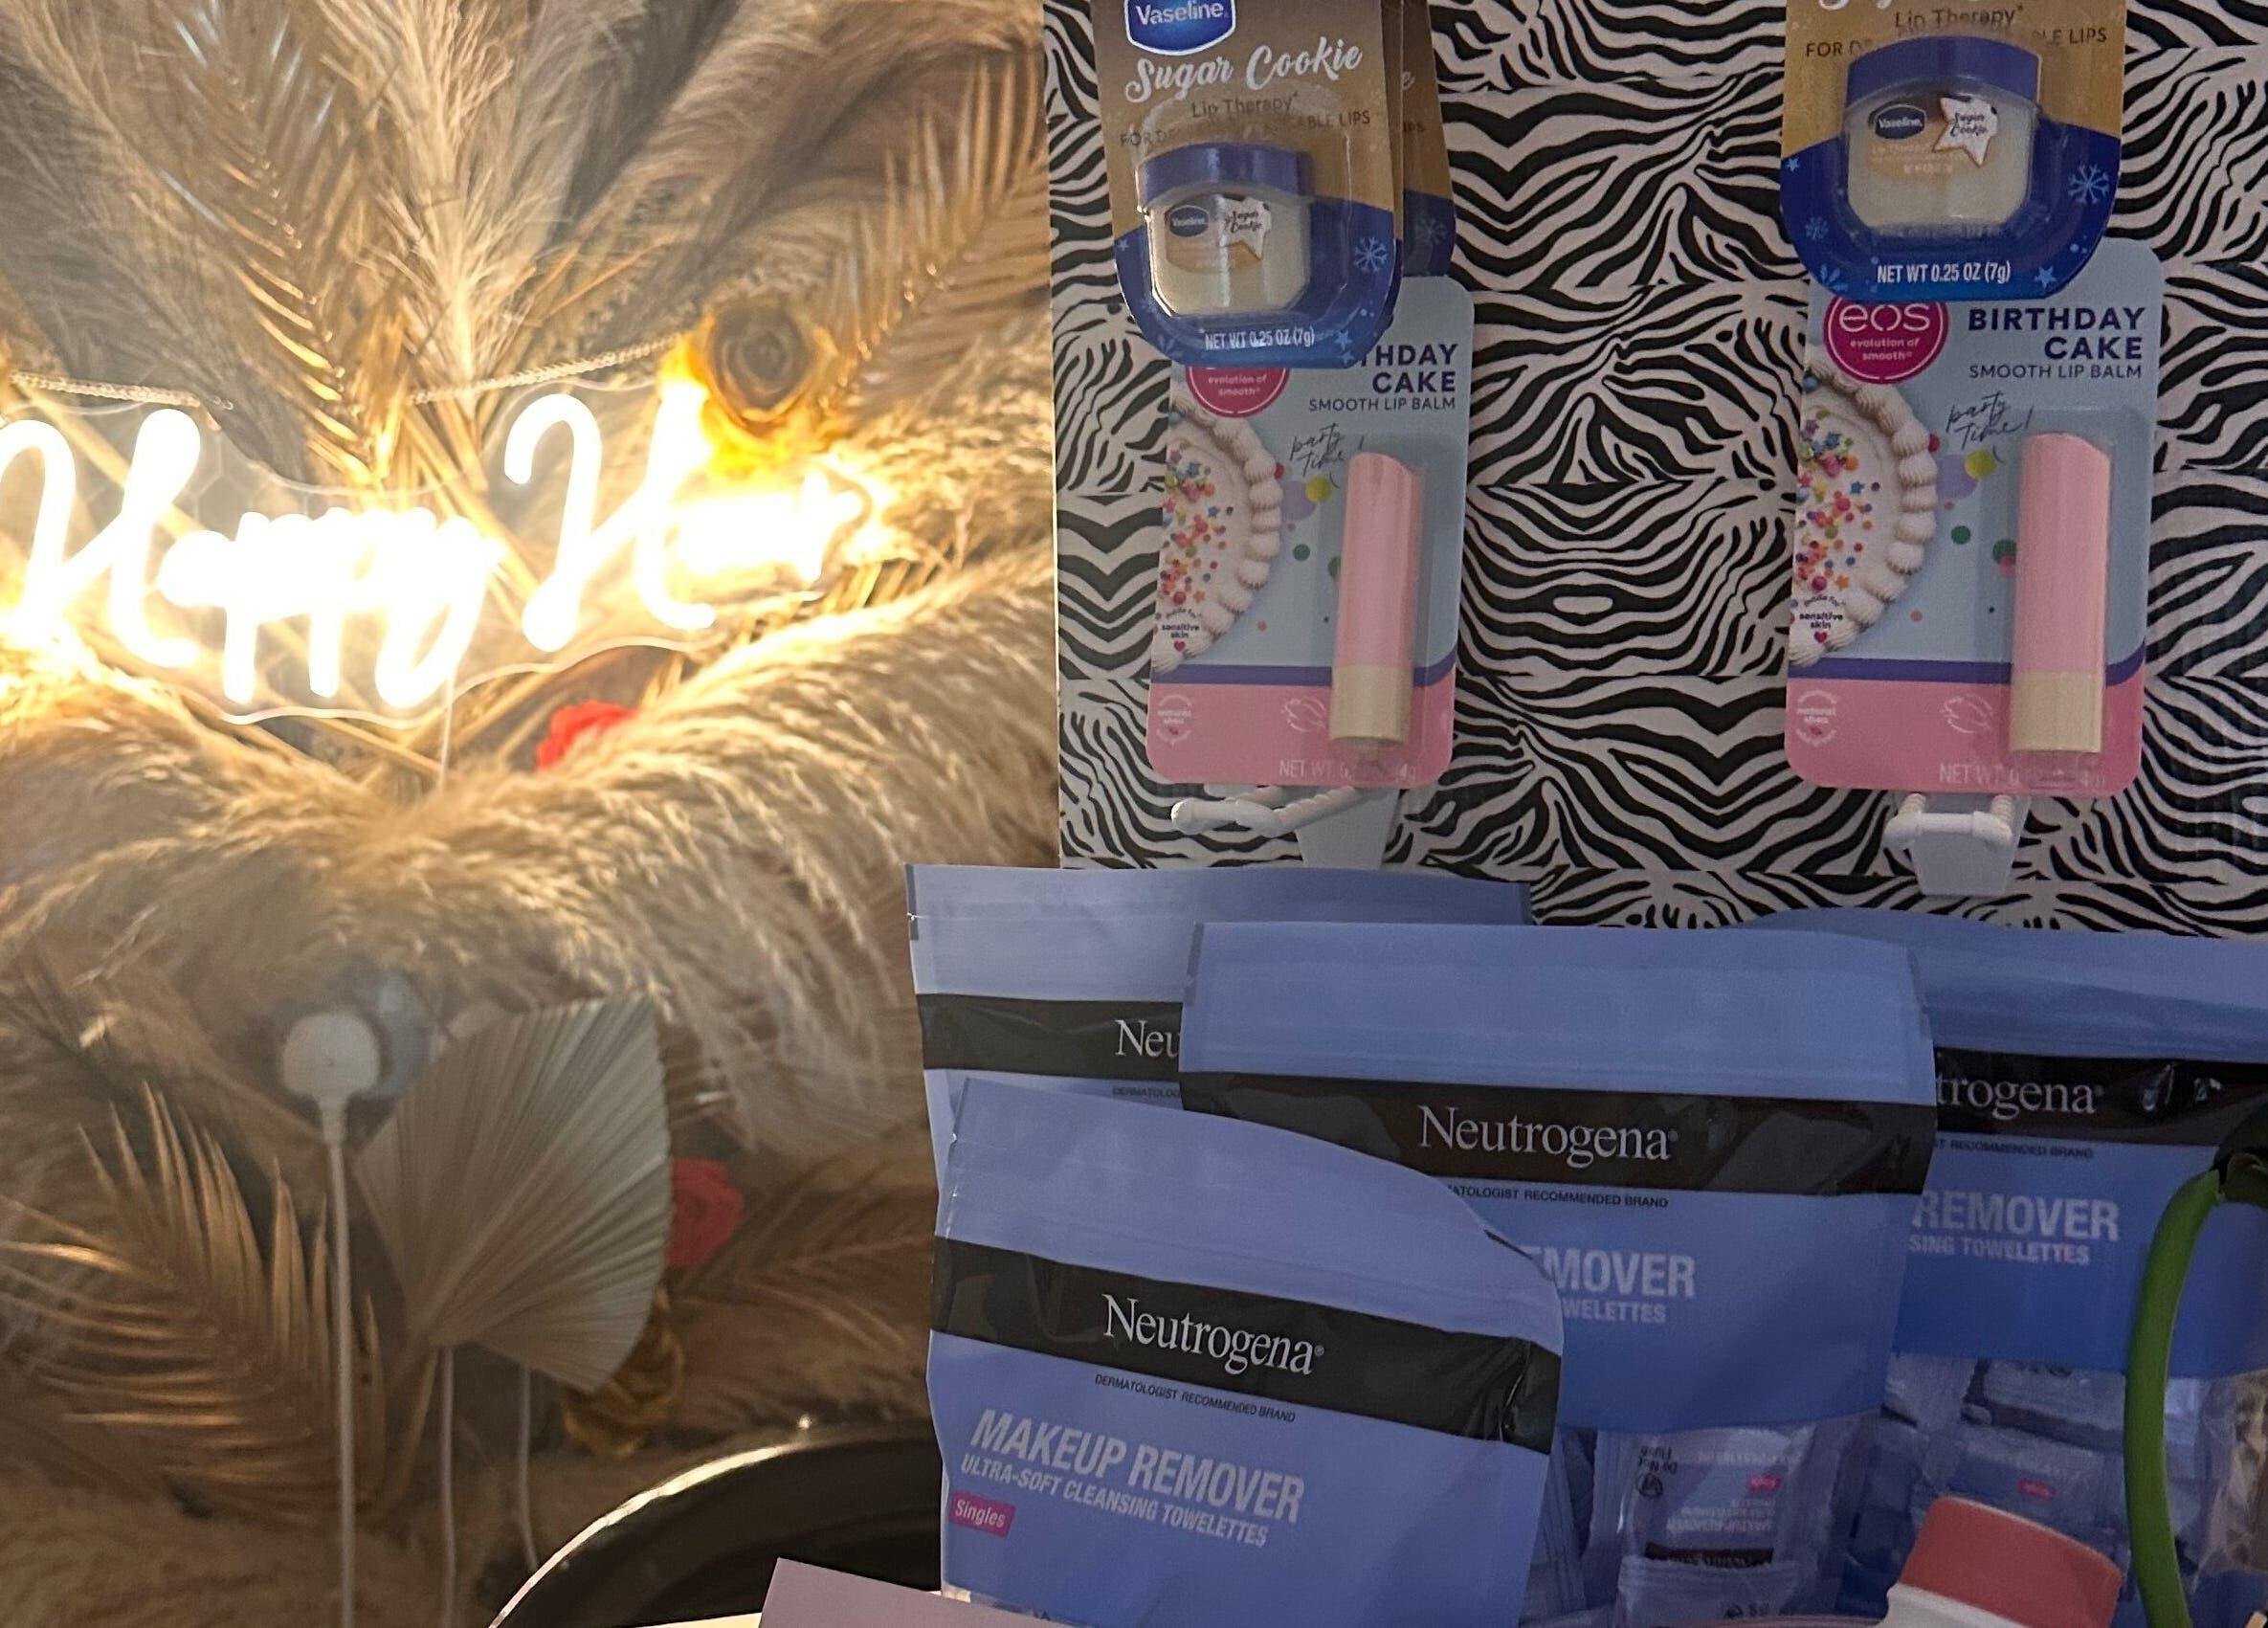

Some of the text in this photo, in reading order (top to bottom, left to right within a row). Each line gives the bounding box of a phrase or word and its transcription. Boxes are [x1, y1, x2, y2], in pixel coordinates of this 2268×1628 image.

[1136, 1, 1224, 26] Vaseline
[1806, 40, 1842, 57] FOR
[2069, 27, 2107, 45] LIPS
[1125, 36, 1363, 103] Sugar Cookie
[1340, 110, 1371, 126] LIPS
[1878, 259, 2011, 284] NET WT 0.25 OZ (7g)
[1839, 303, 1930, 332] eos
[1968, 307, 2146, 331] BIRTHDAY
[1205, 333, 1226, 350] NET
[1276, 329, 1291, 346] OZ
[1294, 326, 1315, 347] (7g)
[1850, 337, 1905, 348] evolution
[2044, 337, 2143, 360] CAKE
[1862, 350, 1905, 361] smooth
[1372, 371, 1456, 393] CAKE
[1969, 365, 2142, 379] SMOOTH LIP BALM
[1309, 398, 1455, 412] SMOOTH LIP BALM
[1279, 760, 1304, 777] NET
[1937, 1073, 2097, 1120] trogena
[1417, 1104, 1671, 1170] Neutrogena
[1448, 1185, 1669, 1209] ATOLOGIST RECOMMENDED BRAND
[1912, 1191, 2120, 1241] REMOVER
[1963, 1237, 2090, 1266] TOWELETTES
[1522, 1245, 1696, 1298] MOVER
[1101, 1293, 1314, 1375] Neutrogena
[1095, 1373, 1297, 1423] DERMATOLOGIST RECOMMENDED BRAND
[970, 1409, 1304, 1525] MAKEUP REMOVER
[961, 1453, 1269, 1548] ULTRA-SOFT CLEANSING TOWELETTES
[955, 1498, 1006, 1529] Singles
